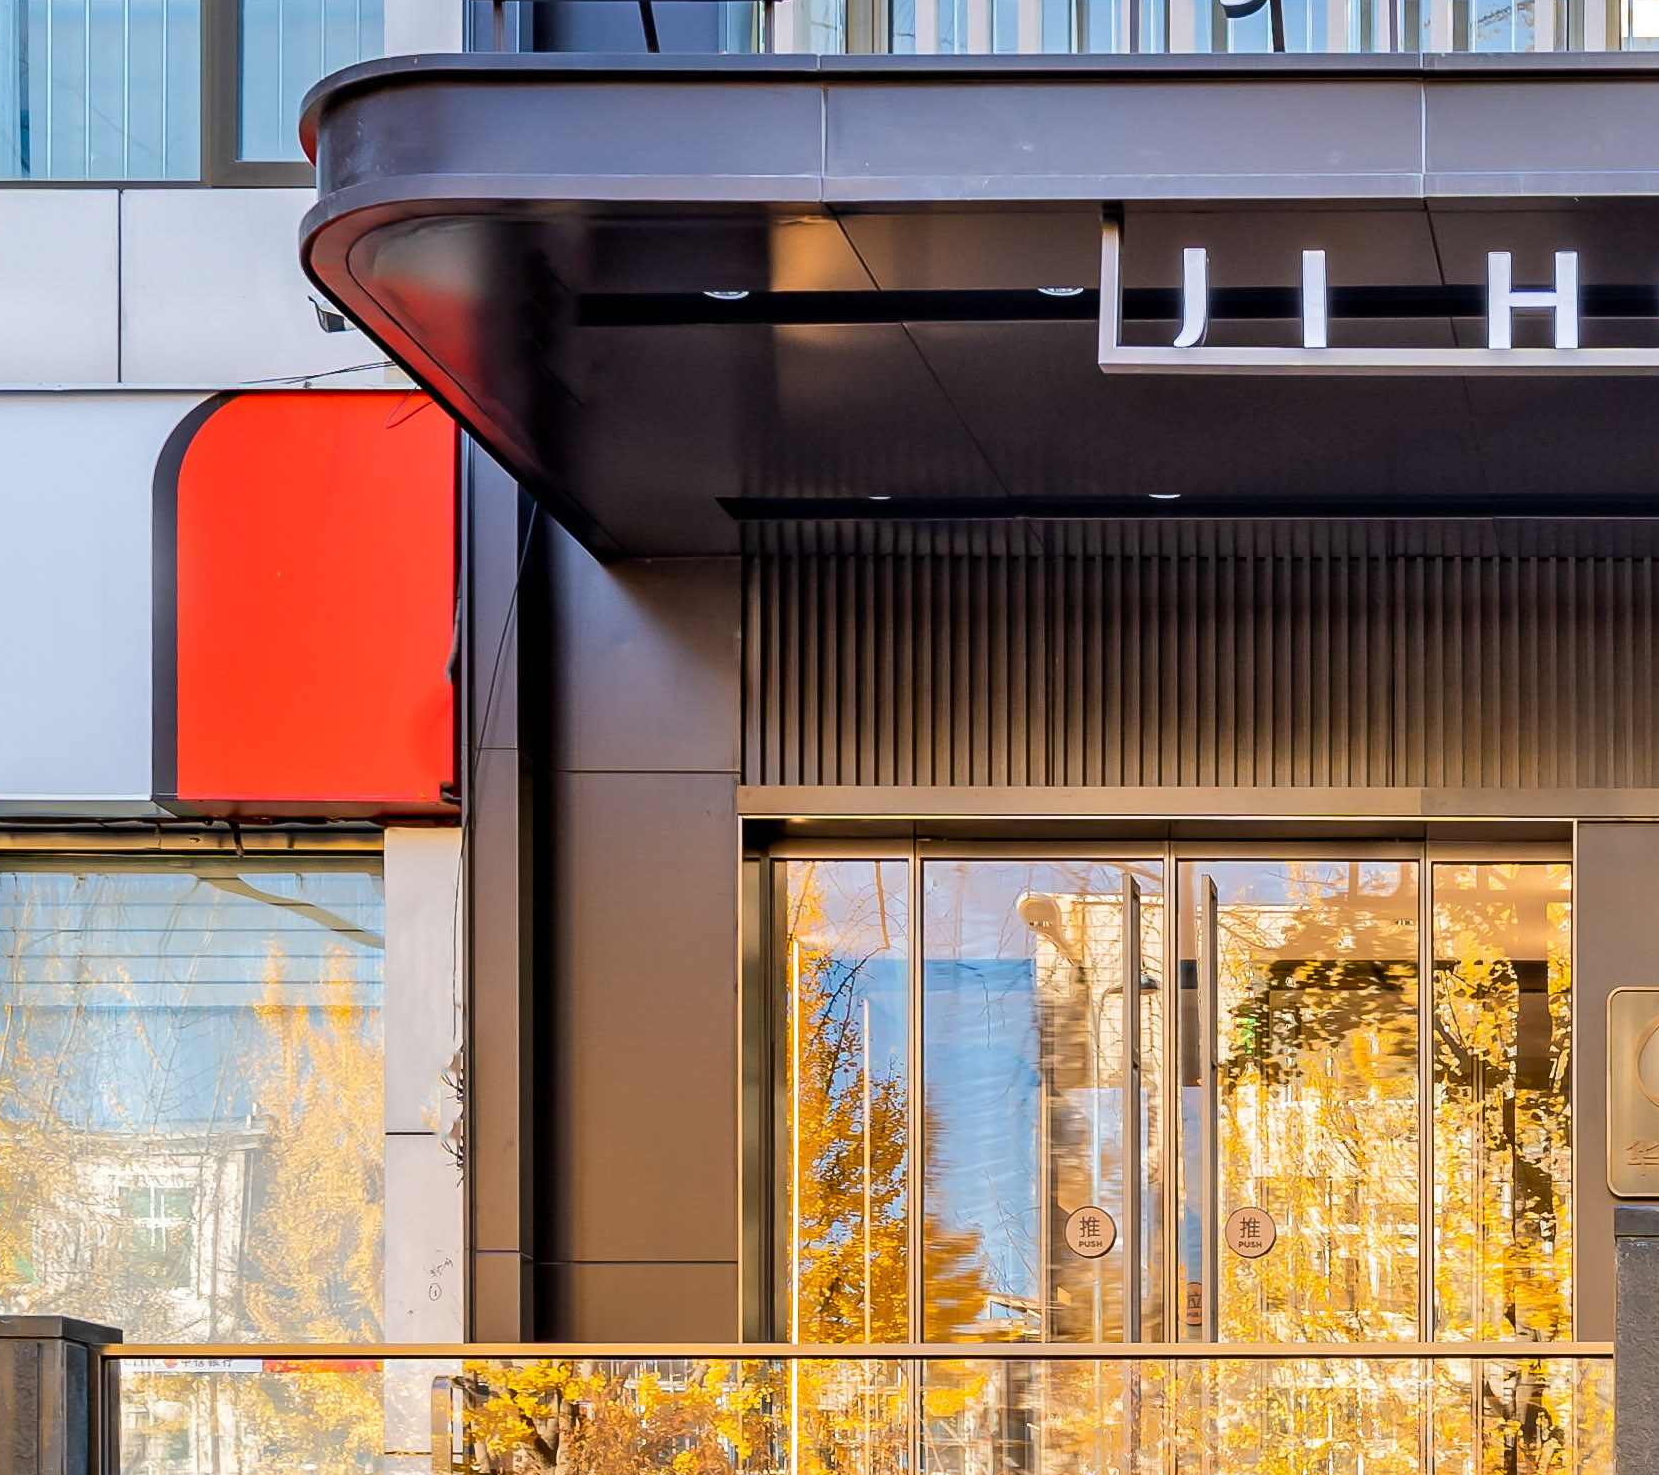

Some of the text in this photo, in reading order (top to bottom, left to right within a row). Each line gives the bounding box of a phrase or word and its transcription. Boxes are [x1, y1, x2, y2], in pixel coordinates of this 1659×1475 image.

[1173, 246, 1327, 350] JI
[1079, 1216, 1101, 1238] 推
[1239, 1217, 1261, 1239] 推
[1078, 1240, 1103, 1248] PUSH
[1238, 1241, 1262, 1249] PUSH
